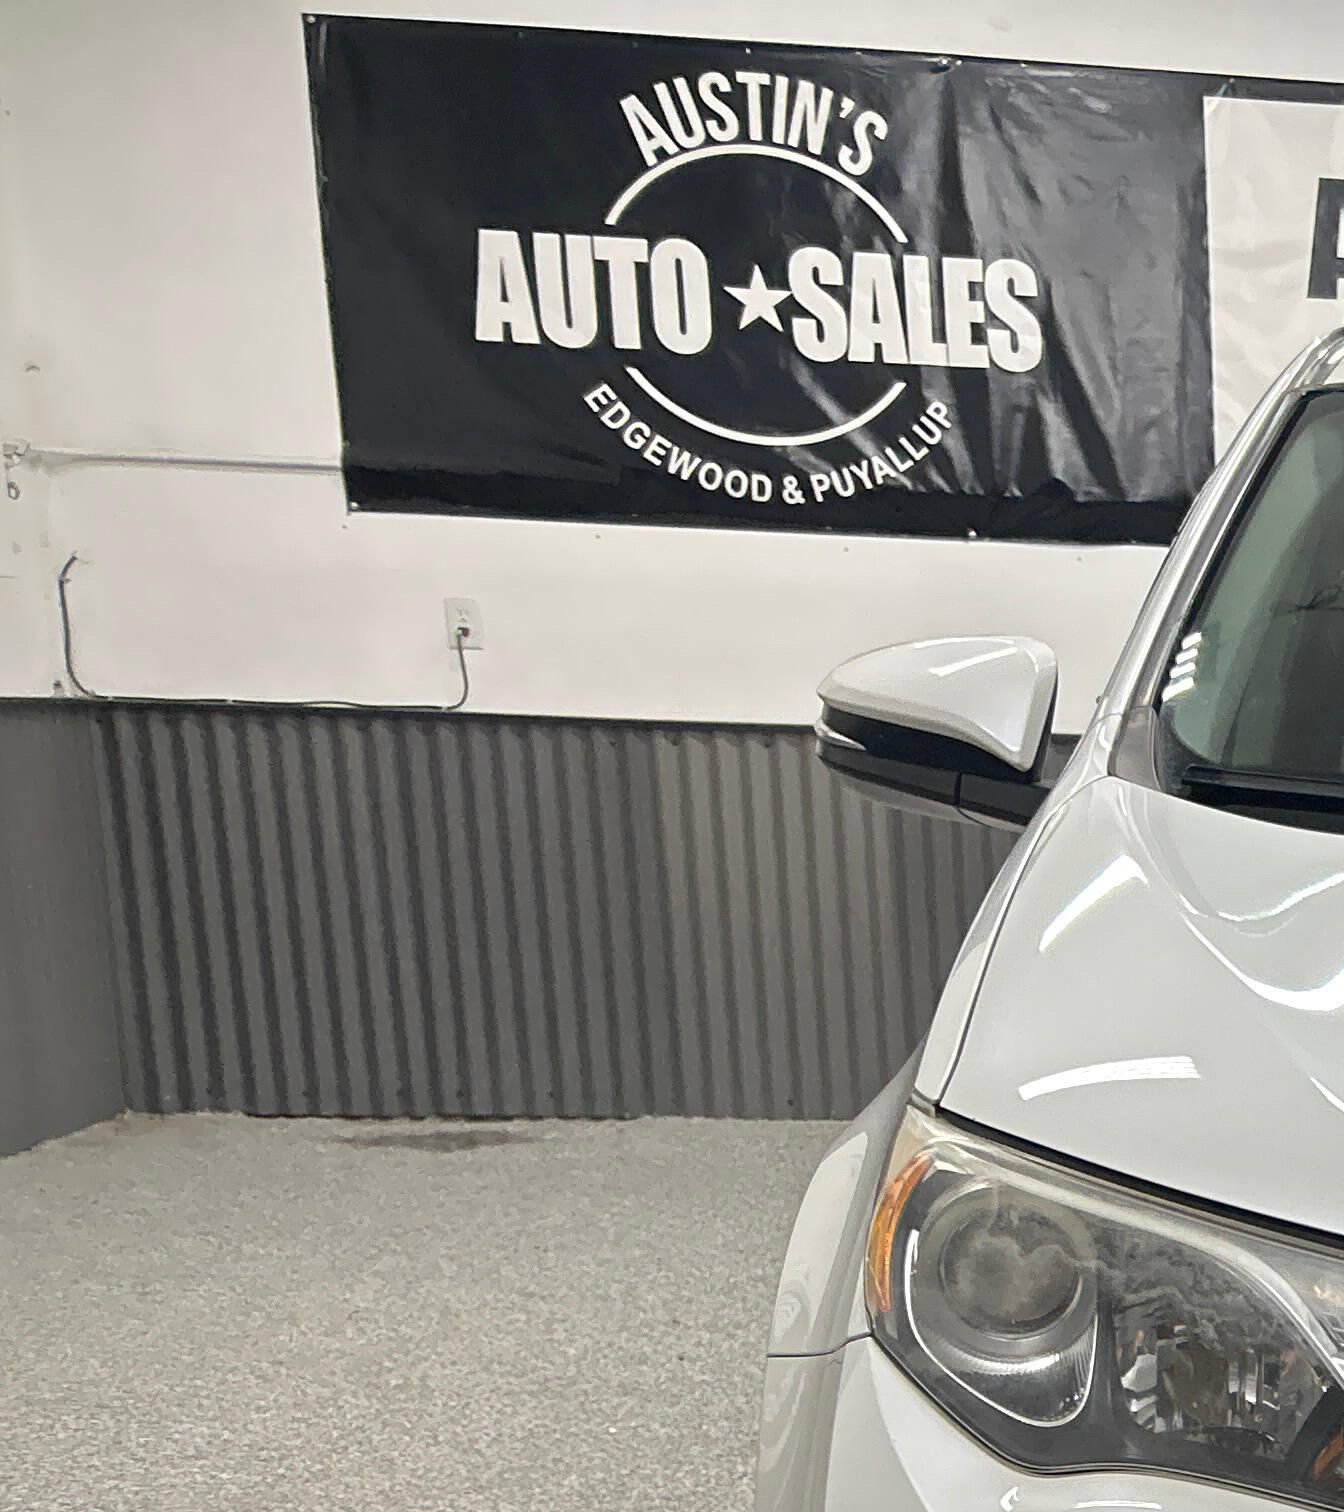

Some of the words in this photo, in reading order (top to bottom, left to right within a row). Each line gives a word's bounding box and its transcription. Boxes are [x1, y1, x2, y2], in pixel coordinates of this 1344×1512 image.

[619, 69, 887, 177] AUSTIN'S
[475, 229, 713, 355] AUTO
[788, 245, 1043, 373] SALES
[583, 383, 773, 505] EDGEWOOD
[782, 480, 805, 506] &
[812, 401, 954, 503] PUYALLUP
